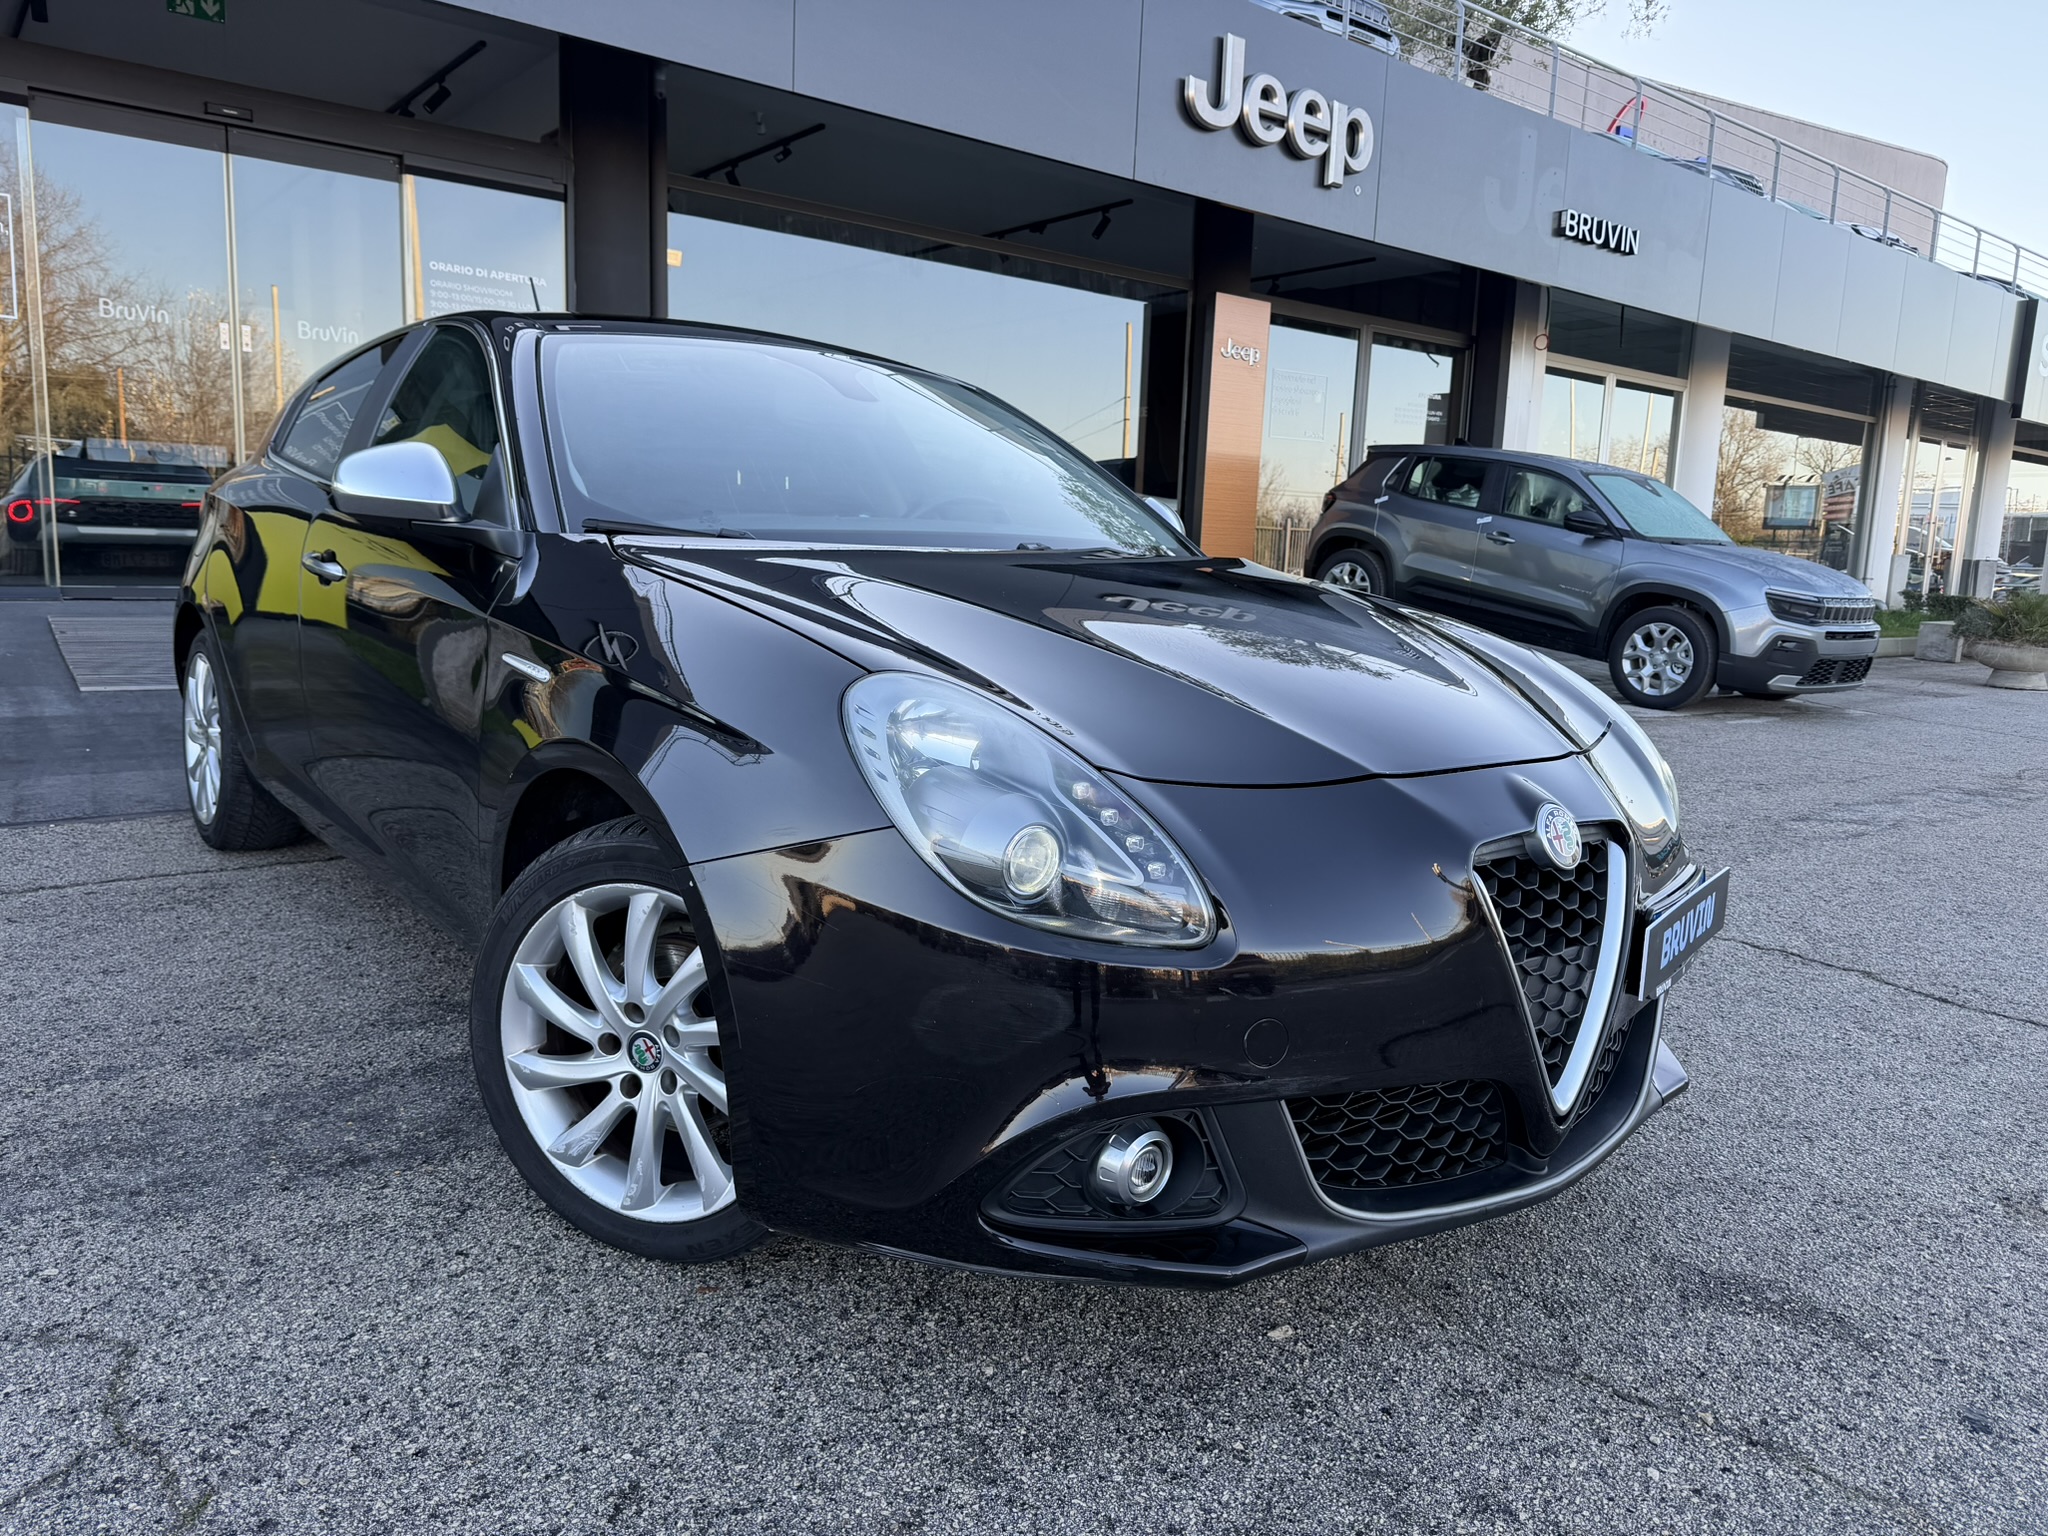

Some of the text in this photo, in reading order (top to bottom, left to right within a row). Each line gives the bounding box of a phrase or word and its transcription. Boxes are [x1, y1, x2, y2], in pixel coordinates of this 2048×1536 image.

[1185, 32, 1374, 188] Jeep
[1565, 209, 1640, 255] BRUVIN
[429, 260, 547, 287] ORARIO DI APERTURA
[430, 279, 513, 297] ORARIO SHOWROOM
[99, 297, 169, 324] BruVin
[297, 320, 359, 344] BruVin
[1220, 338, 1260, 366] Jeep
[1546, 814, 1554, 840] ALFA
[562, 851, 599, 872] Sport
[1660, 892, 1716, 970] BRUVIN
